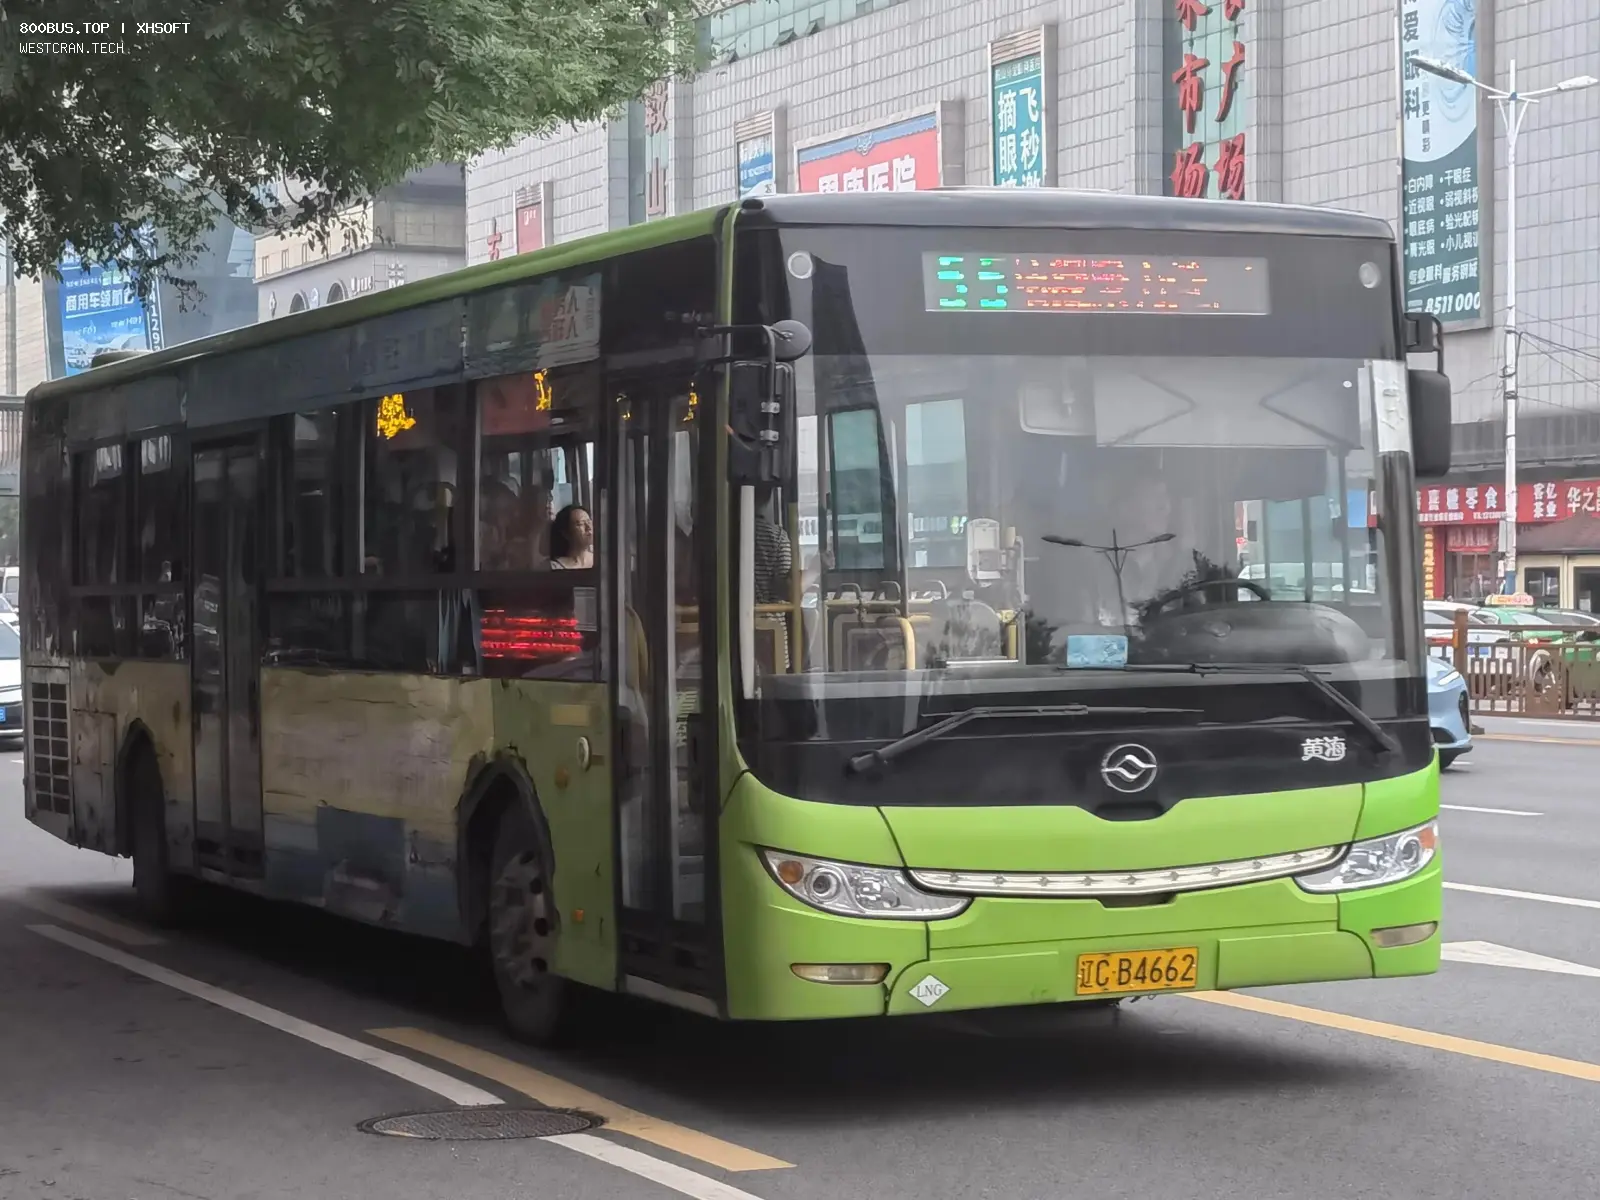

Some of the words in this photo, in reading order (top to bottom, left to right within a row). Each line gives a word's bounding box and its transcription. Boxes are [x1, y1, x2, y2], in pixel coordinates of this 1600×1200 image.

[1403, 0, 1420, 120] 爱眼科
[1444, 167, 1472, 186] 干眼症
[1408, 195, 1435, 215] 近视眼
[1301, 736, 1347, 761] 黄海
[916, 983, 943, 998] LNG
